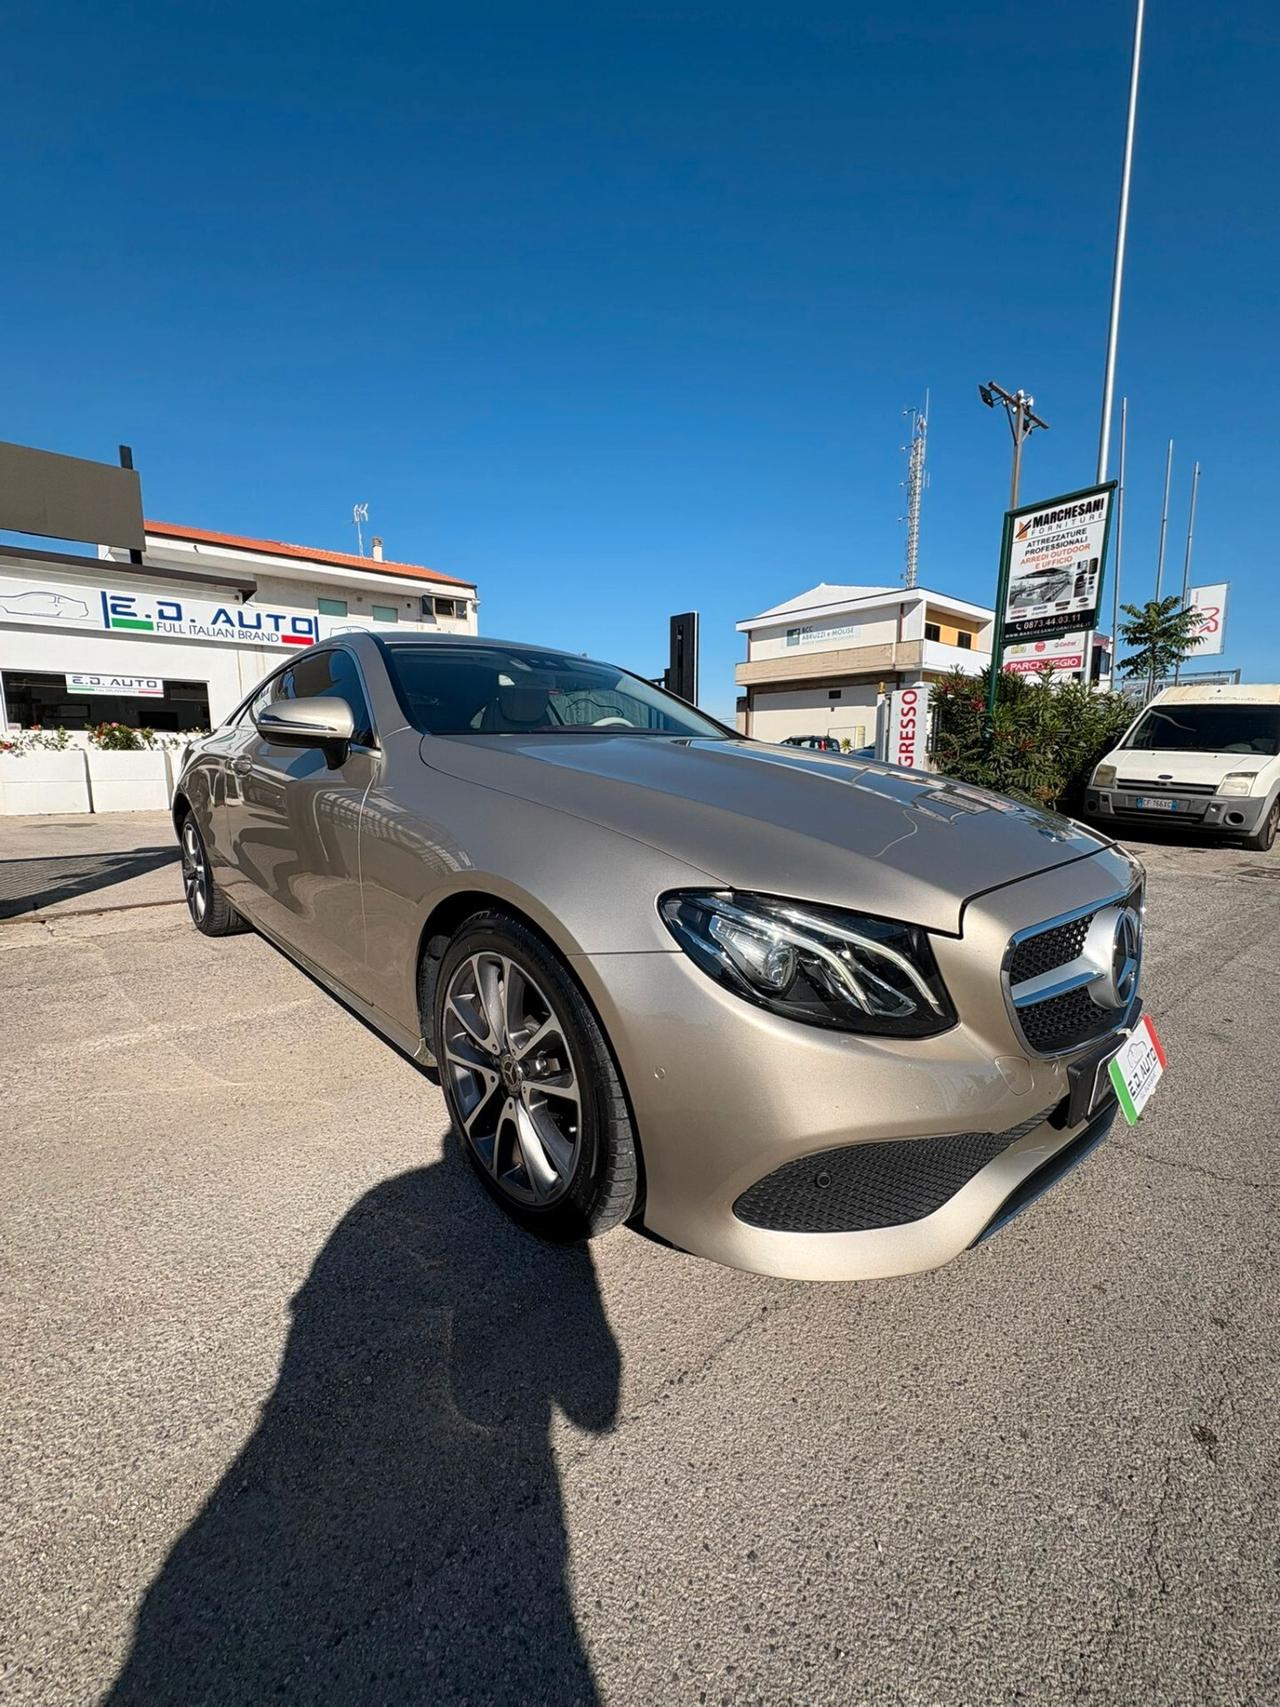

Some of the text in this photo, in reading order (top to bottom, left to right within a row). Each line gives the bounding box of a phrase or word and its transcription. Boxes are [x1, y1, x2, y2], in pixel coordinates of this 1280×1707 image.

[1031, 512, 1104, 537] FORNITURE
[1032, 498, 1105, 529] MARCHESANI
[1025, 536, 1088, 556] PROFESSIONALI
[1026, 528, 1088, 549] ATTREZZATURE
[1020, 543, 1091, 565] ARREDI OUTDOOR
[1041, 556, 1074, 568] UFFICIO
[155, 621, 280, 643] FULL ITALIAN BRAND
[211, 607, 314, 636] AUTO
[1023, 613, 1081, 630] 0873.44.03.11
[110, 678, 158, 689] AUTO
[1139, 1047, 1157, 1080] AUTO
